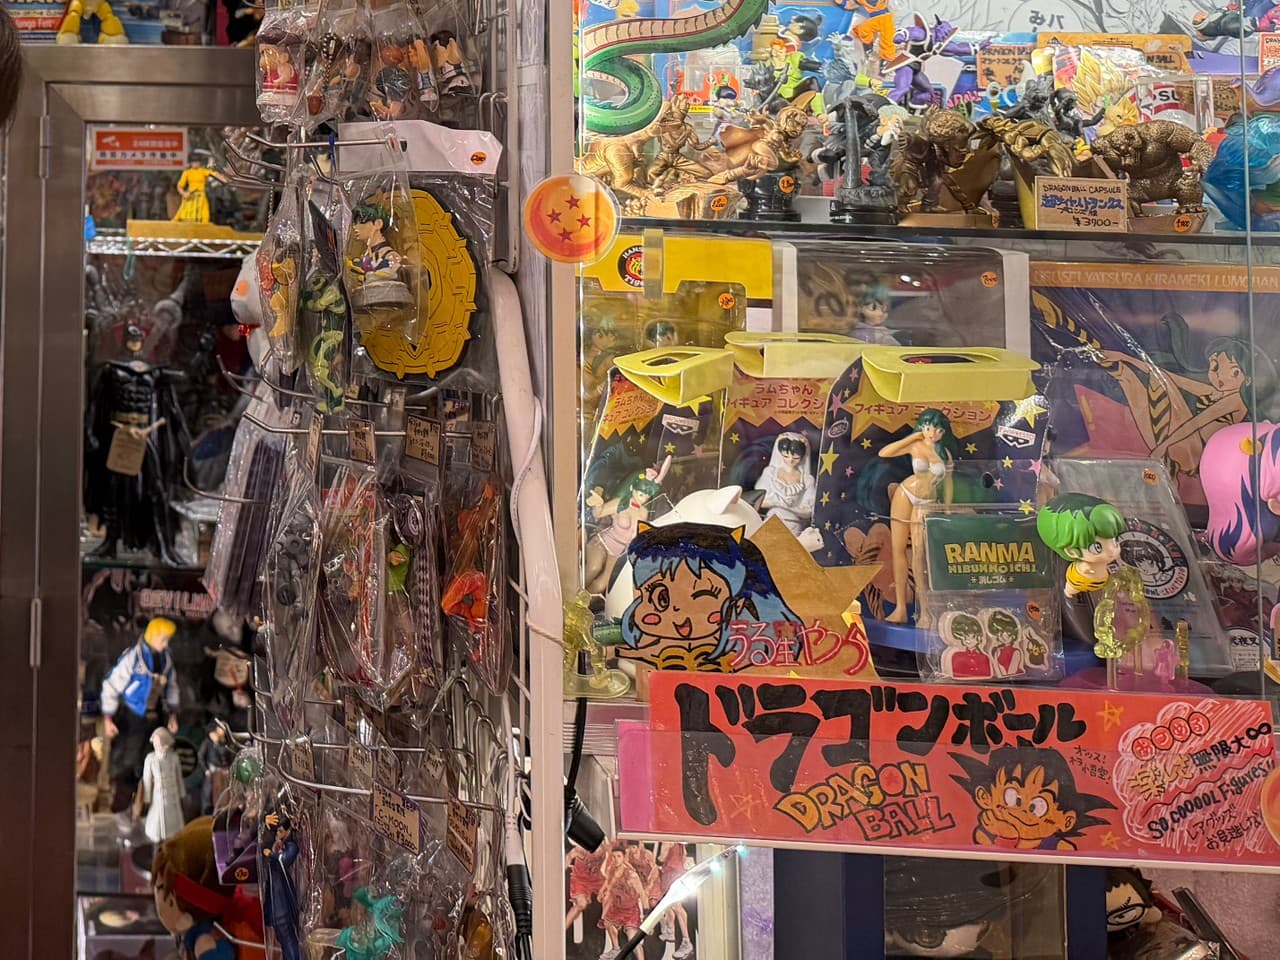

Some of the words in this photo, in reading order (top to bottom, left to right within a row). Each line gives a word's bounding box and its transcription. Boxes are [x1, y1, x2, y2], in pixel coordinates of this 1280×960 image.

[753, 382, 814, 396] ラムちゃん
[778, 397, 825, 411] コレクシ
[853, 402, 909, 416] フィギュア
[944, 542, 1036, 565] RANMA
[728, 619, 870, 676] うる星やつら
[674, 682, 1087, 826] ドラゴンボール
[774, 761, 929, 834] DRAGON
[852, 790, 956, 841] BALL
[1206, 811, 1265, 850] お見逃しな
